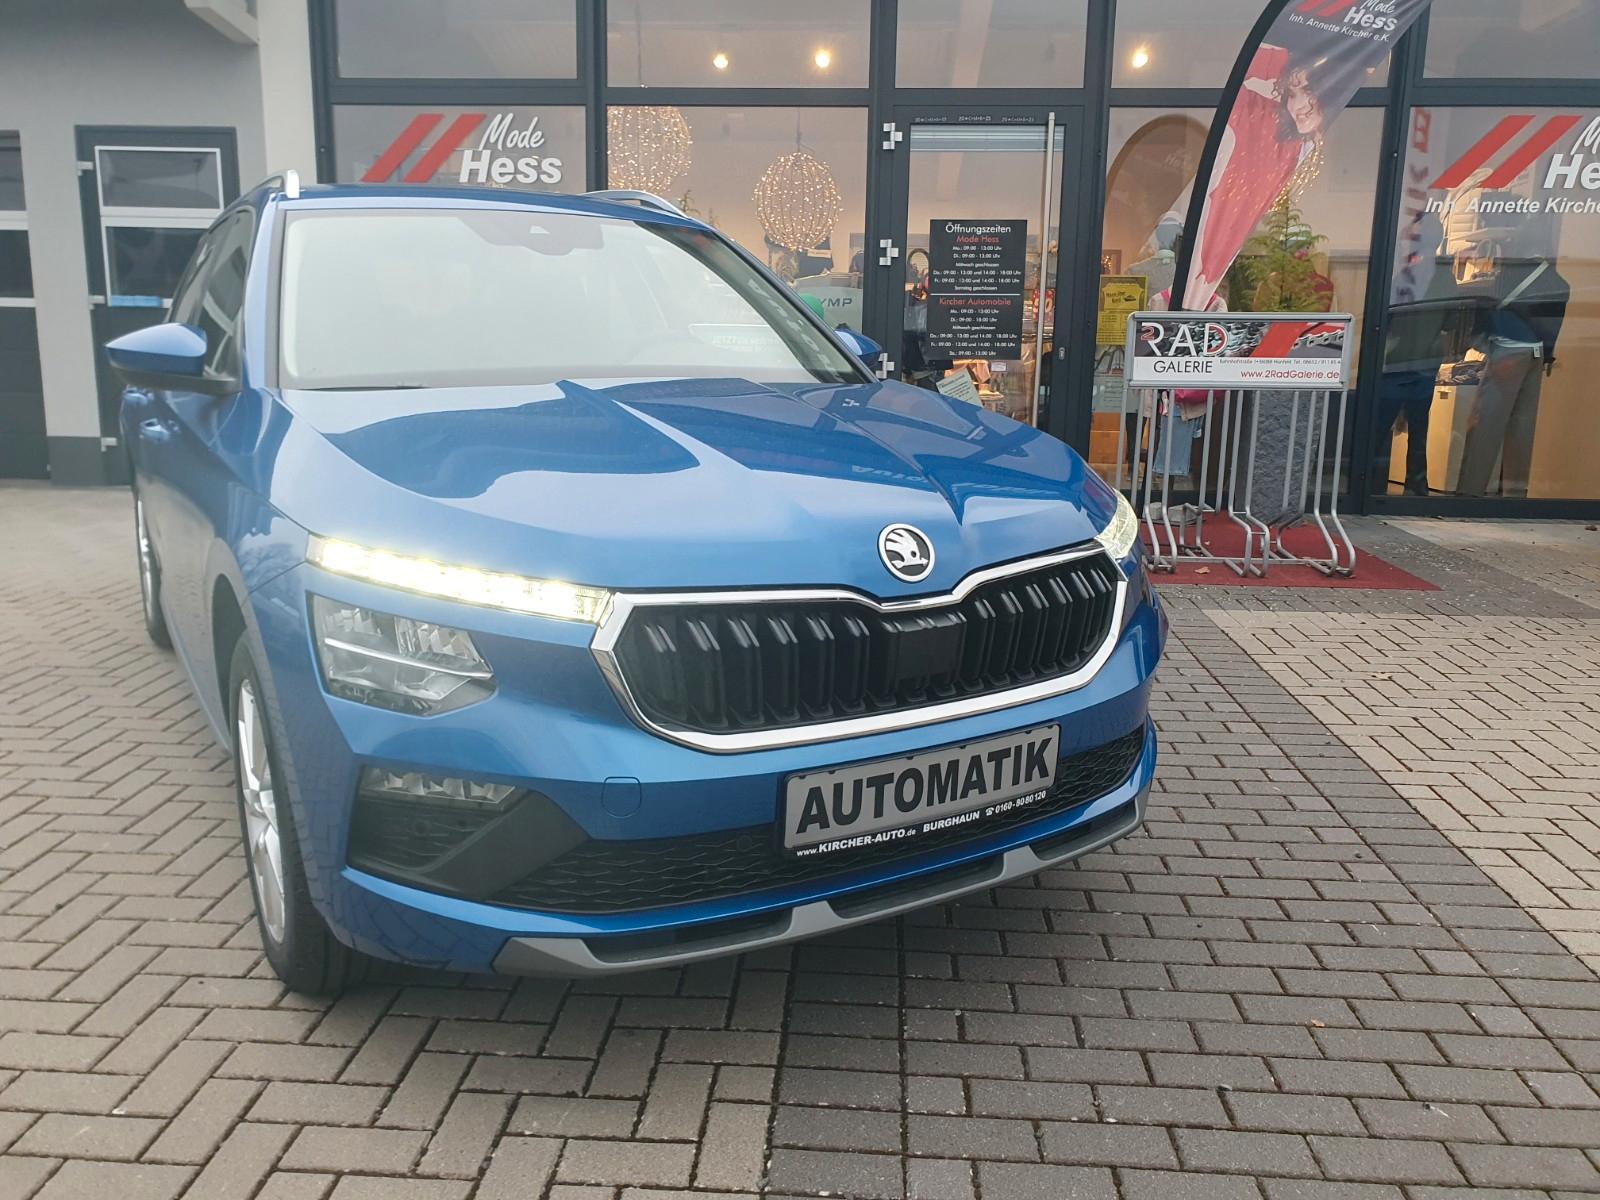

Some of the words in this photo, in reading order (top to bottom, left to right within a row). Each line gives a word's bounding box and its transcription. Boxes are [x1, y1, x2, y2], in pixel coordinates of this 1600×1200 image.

[1360, 0, 1395, 13] Mode
[1288, 13, 1304, 25] Inh.
[1306, 18, 1340, 32] Annette
[1341, 25, 1373, 39] Kircher
[1344, 6, 1397, 31] Hess
[478, 113, 545, 151] Mode
[459, 149, 562, 184] Hess
[1543, 153, 1600, 190] He
[1465, 197, 1540, 213] Annette
[945, 221, 1011, 235] Öffnungszeiten
[956, 235, 979, 243] Mode
[981, 235, 1000, 243] Hess
[939, 297, 966, 305] Kircher
[968, 297, 1011, 305] Automobile
[1153, 360, 1213, 373] GALERIE
[1241, 369, 1340, 379] www.2RadGalerie.de
[796, 737, 1052, 835] AUTOMATIK
[796, 828, 916, 857] www.KIRCHER-AUTO.de
[922, 811, 980, 833] BURGHAUN
